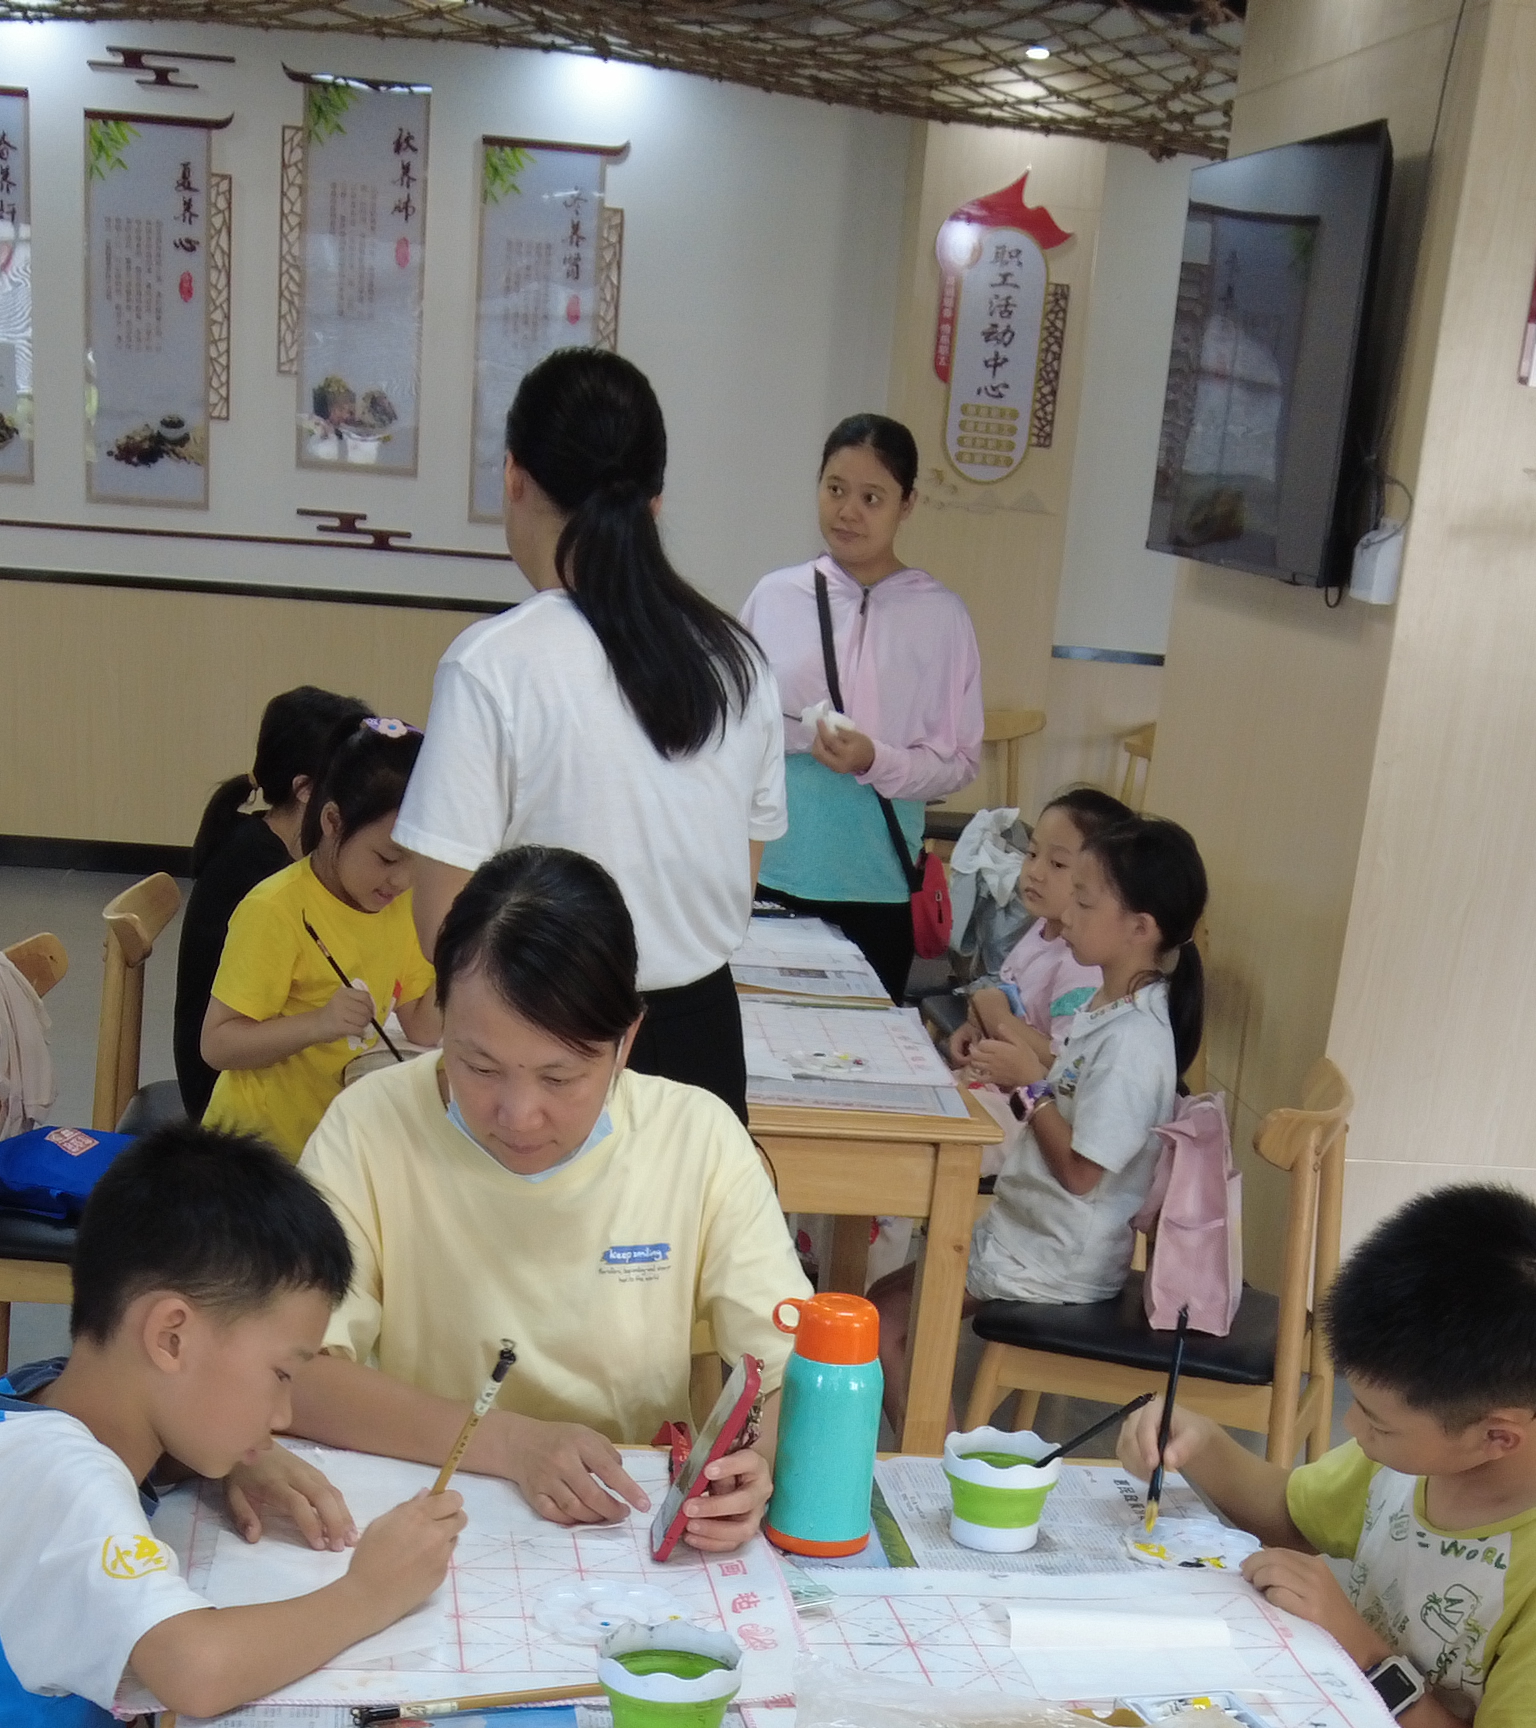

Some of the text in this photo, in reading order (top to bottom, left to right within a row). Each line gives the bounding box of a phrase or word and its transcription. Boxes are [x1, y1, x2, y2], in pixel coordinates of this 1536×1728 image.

[976, 244, 1024, 400] 职工活动中心
